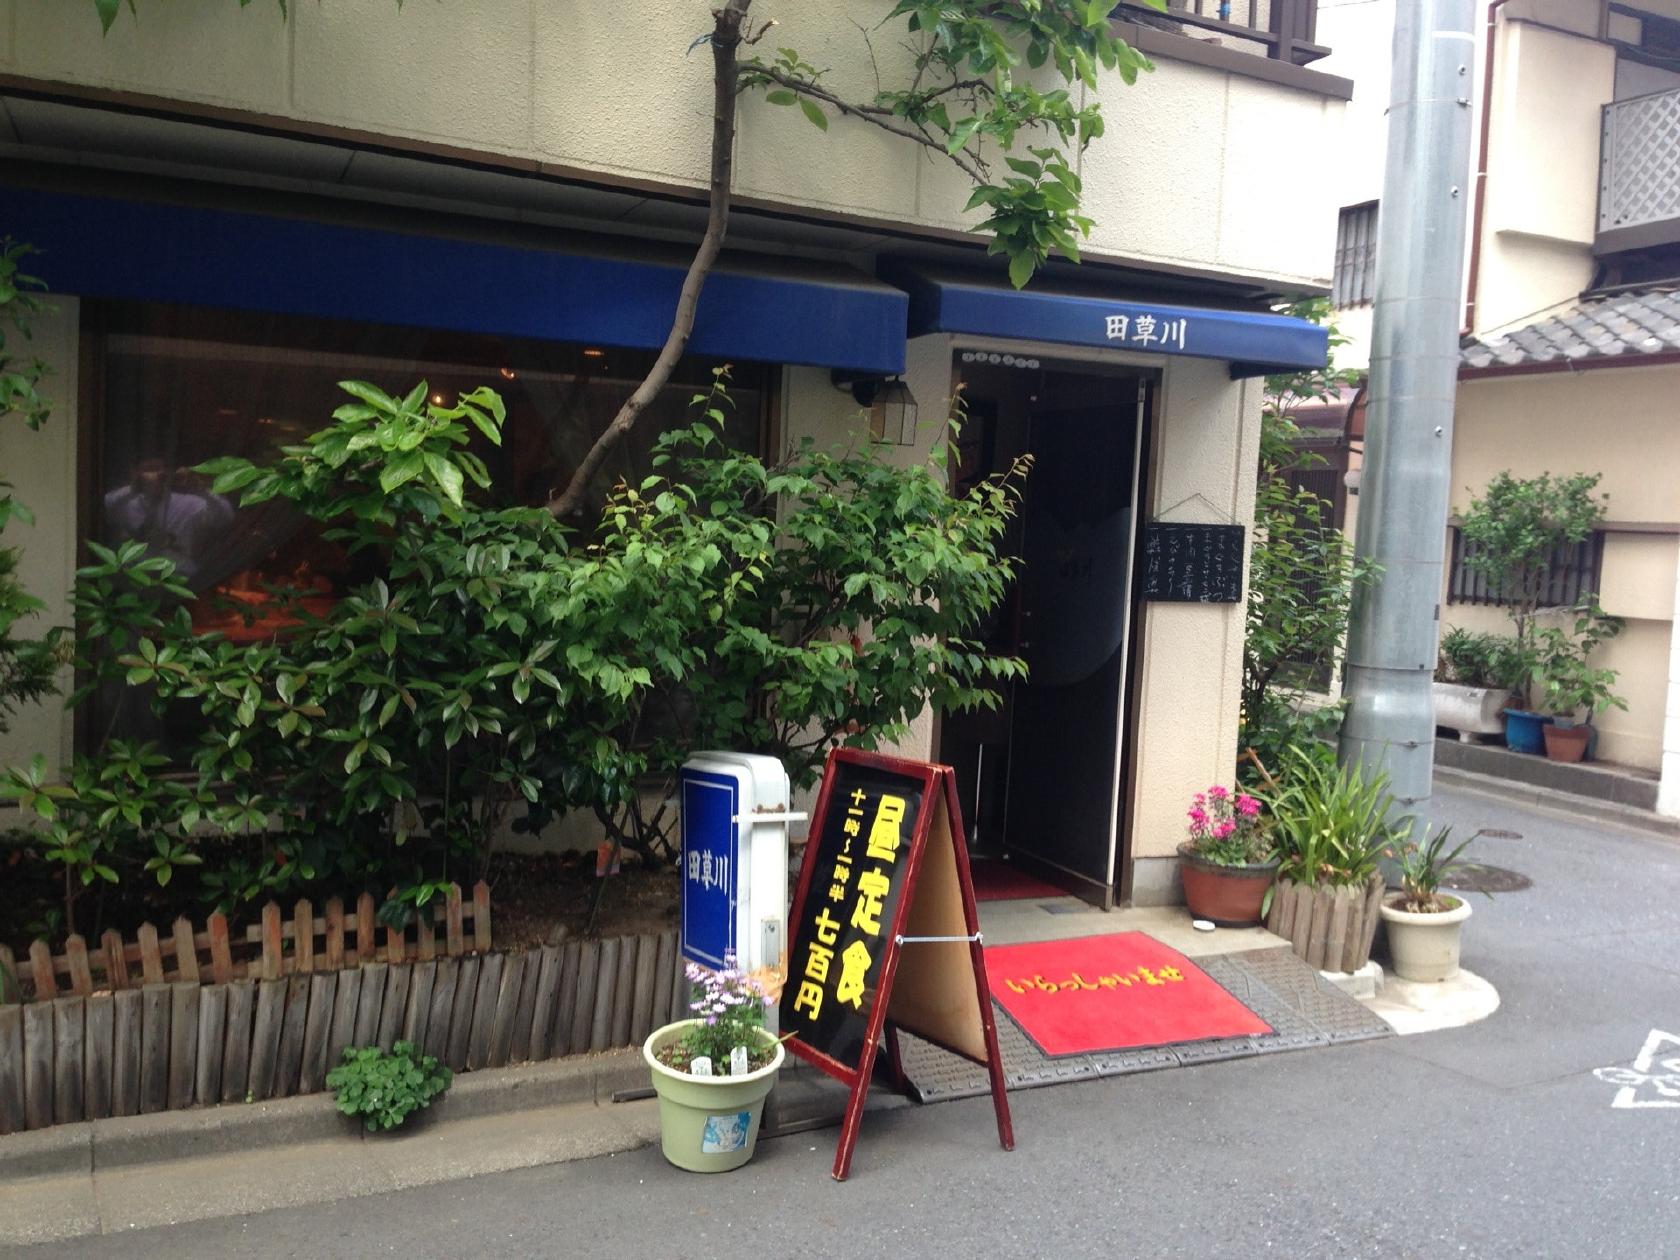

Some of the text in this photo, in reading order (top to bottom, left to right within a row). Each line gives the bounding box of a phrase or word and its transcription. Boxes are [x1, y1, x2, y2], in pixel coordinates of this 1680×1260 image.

[1105, 314, 1187, 350] 田草川
[688, 849, 729, 896] 田草川
[837, 794, 906, 1010] 昼定食
[794, 907, 841, 1021] 七百円
[1005, 964, 1185, 995] いらっしゃいませ
